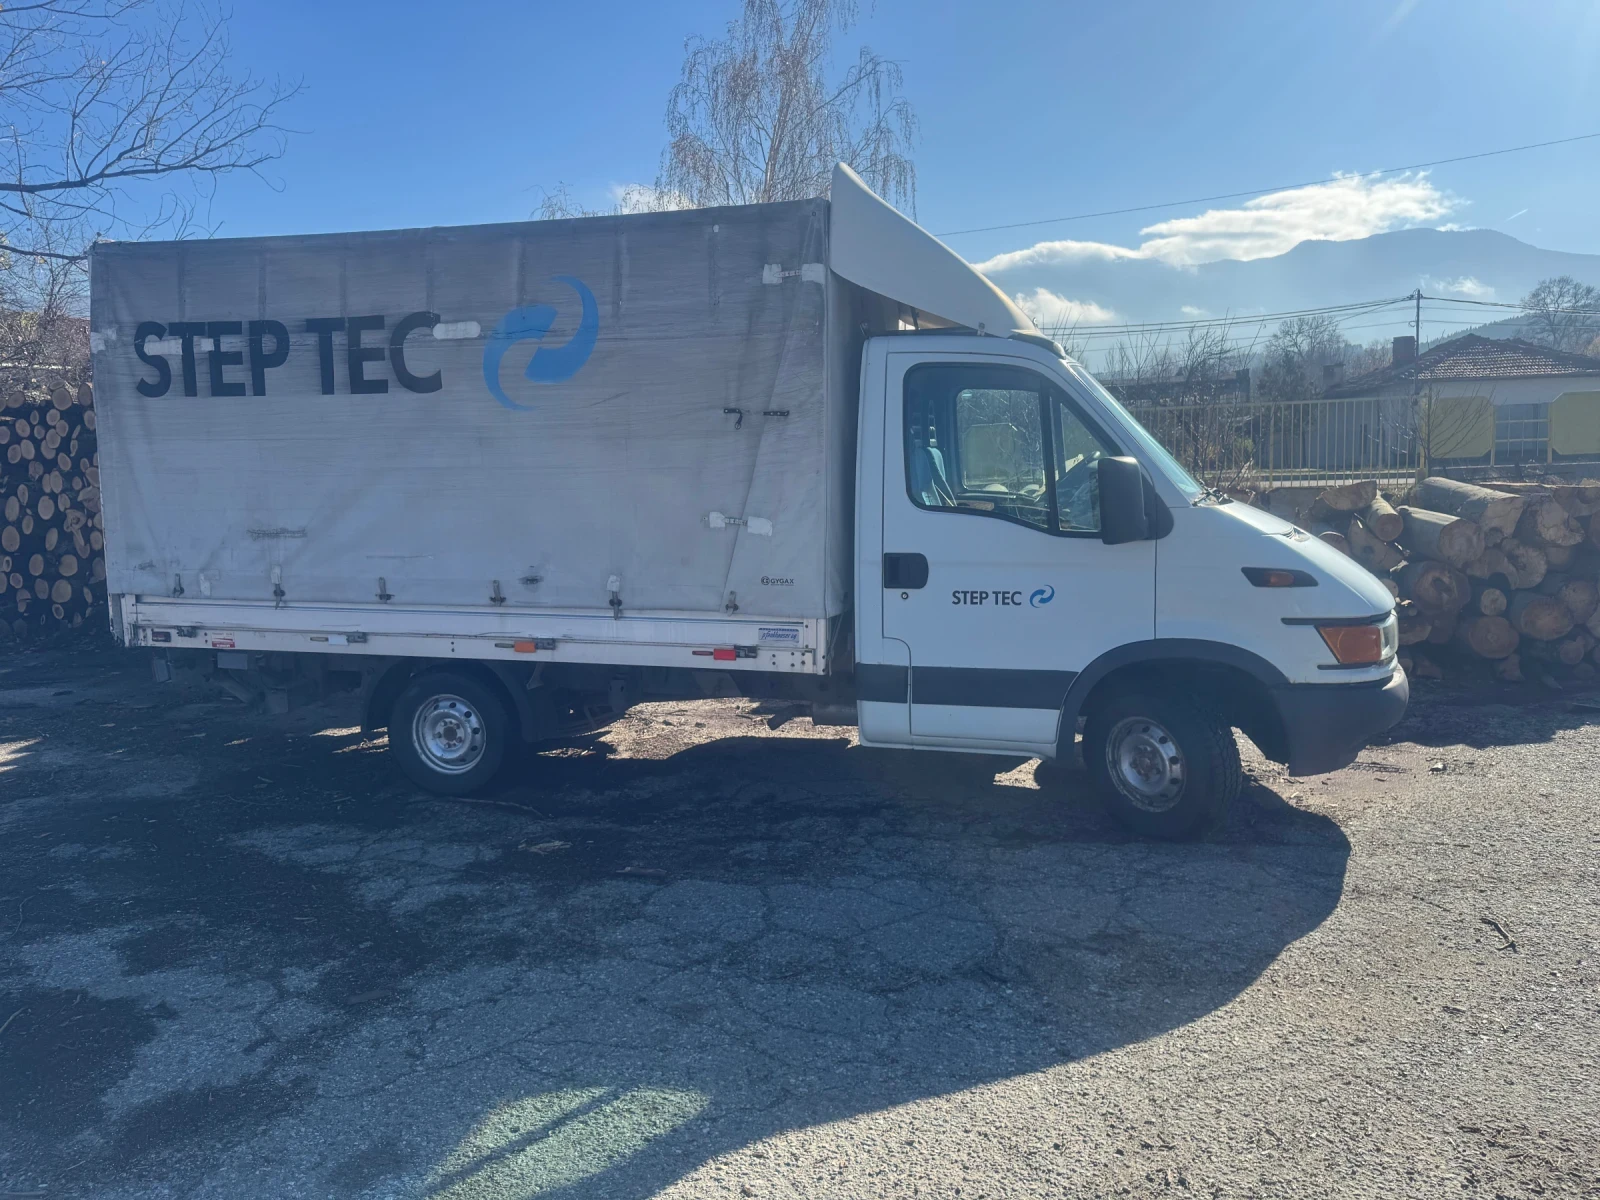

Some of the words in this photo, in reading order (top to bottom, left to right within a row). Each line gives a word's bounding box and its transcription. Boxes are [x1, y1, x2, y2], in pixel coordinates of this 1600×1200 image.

[133, 320, 290, 398] STEP
[305, 311, 443, 394] TEC
[952, 590, 989, 605] STEP
[992, 590, 1022, 606] TEC
